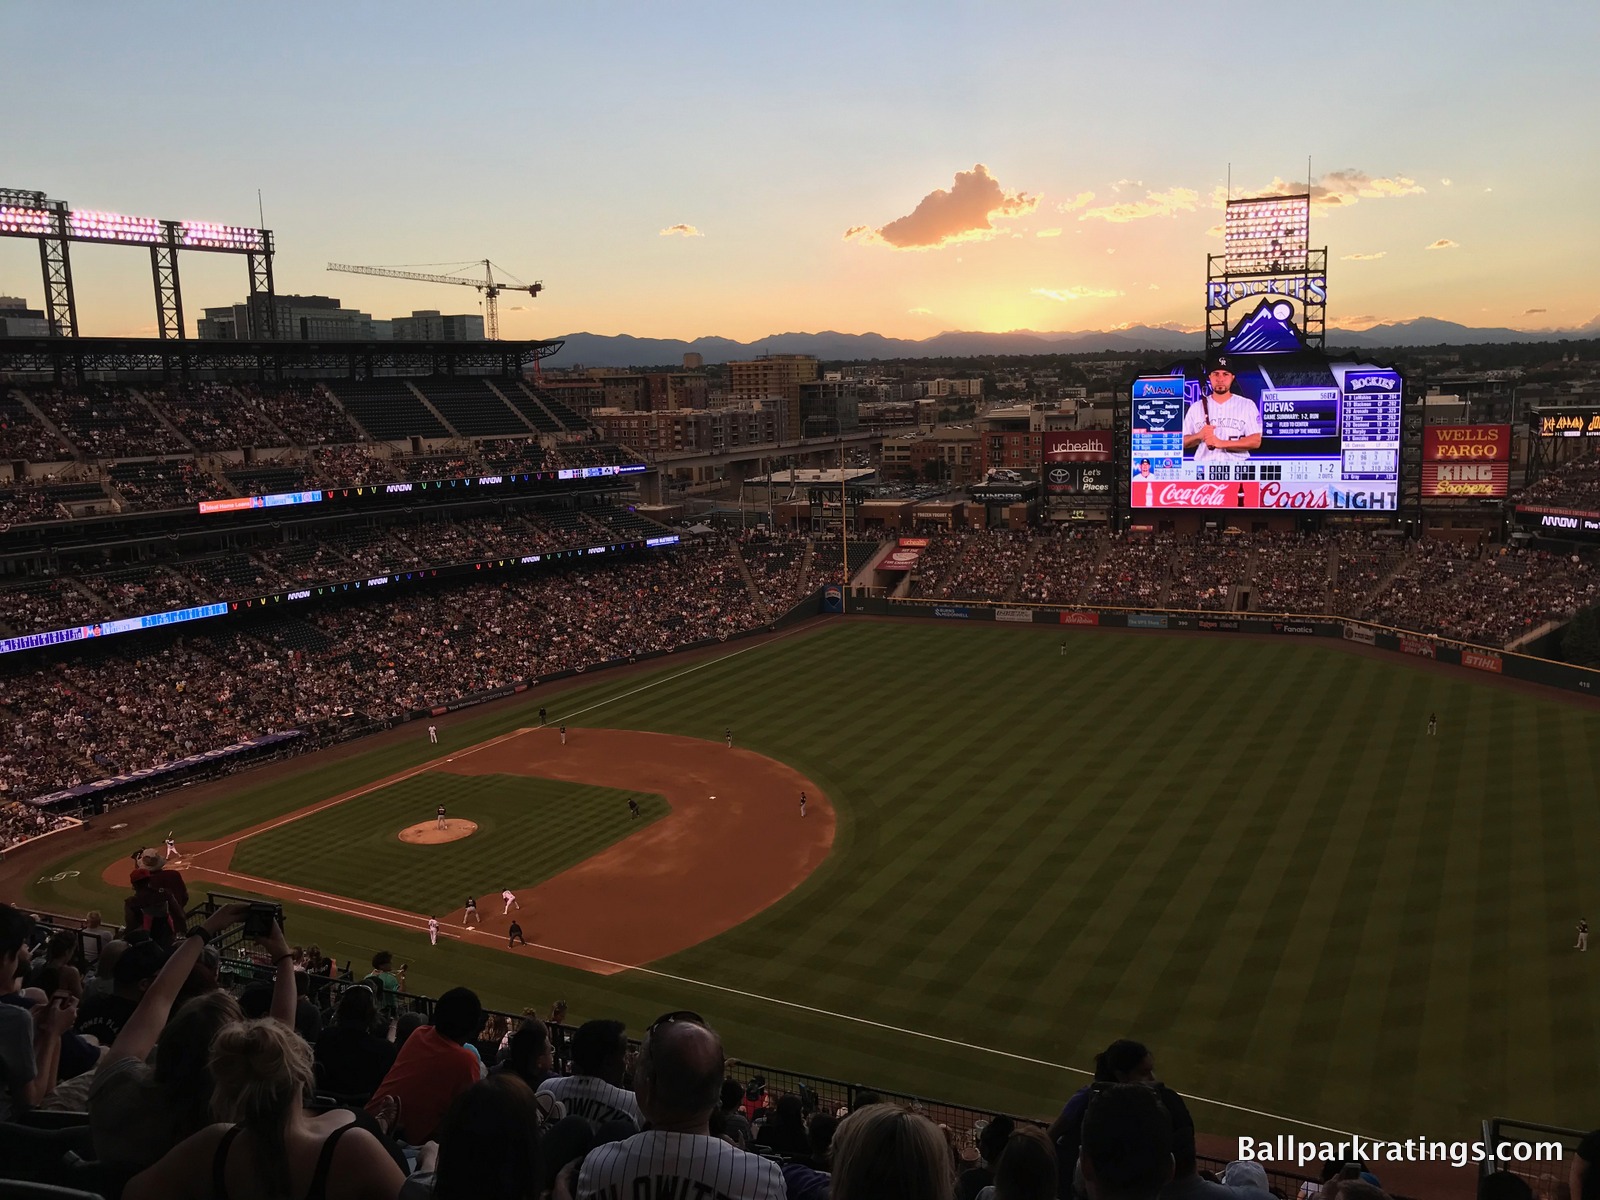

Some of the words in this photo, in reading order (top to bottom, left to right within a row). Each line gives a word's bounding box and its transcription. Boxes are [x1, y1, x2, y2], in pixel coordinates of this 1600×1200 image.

[1208, 277, 1326, 308] ROCKIES
[1142, 384, 1175, 396] MIAMI
[1351, 376, 1396, 390] ROCKIES
[1264, 402, 1294, 412] CUEVAS
[1436, 429, 1499, 441] WELLS
[1052, 438, 1104, 452] uchealth
[1437, 444, 1498, 456] FARGO
[1437, 465, 1493, 481] KING
[1159, 483, 1229, 505] Coca-Cola
[1436, 480, 1494, 496] Soopers
[1260, 482, 1329, 508] Coors
[1333, 492, 1396, 509] LIGHT
[1541, 516, 1578, 529] ARROW
[1284, 624, 1313, 634] Fanatics
[1464, 654, 1498, 670] STIHL
